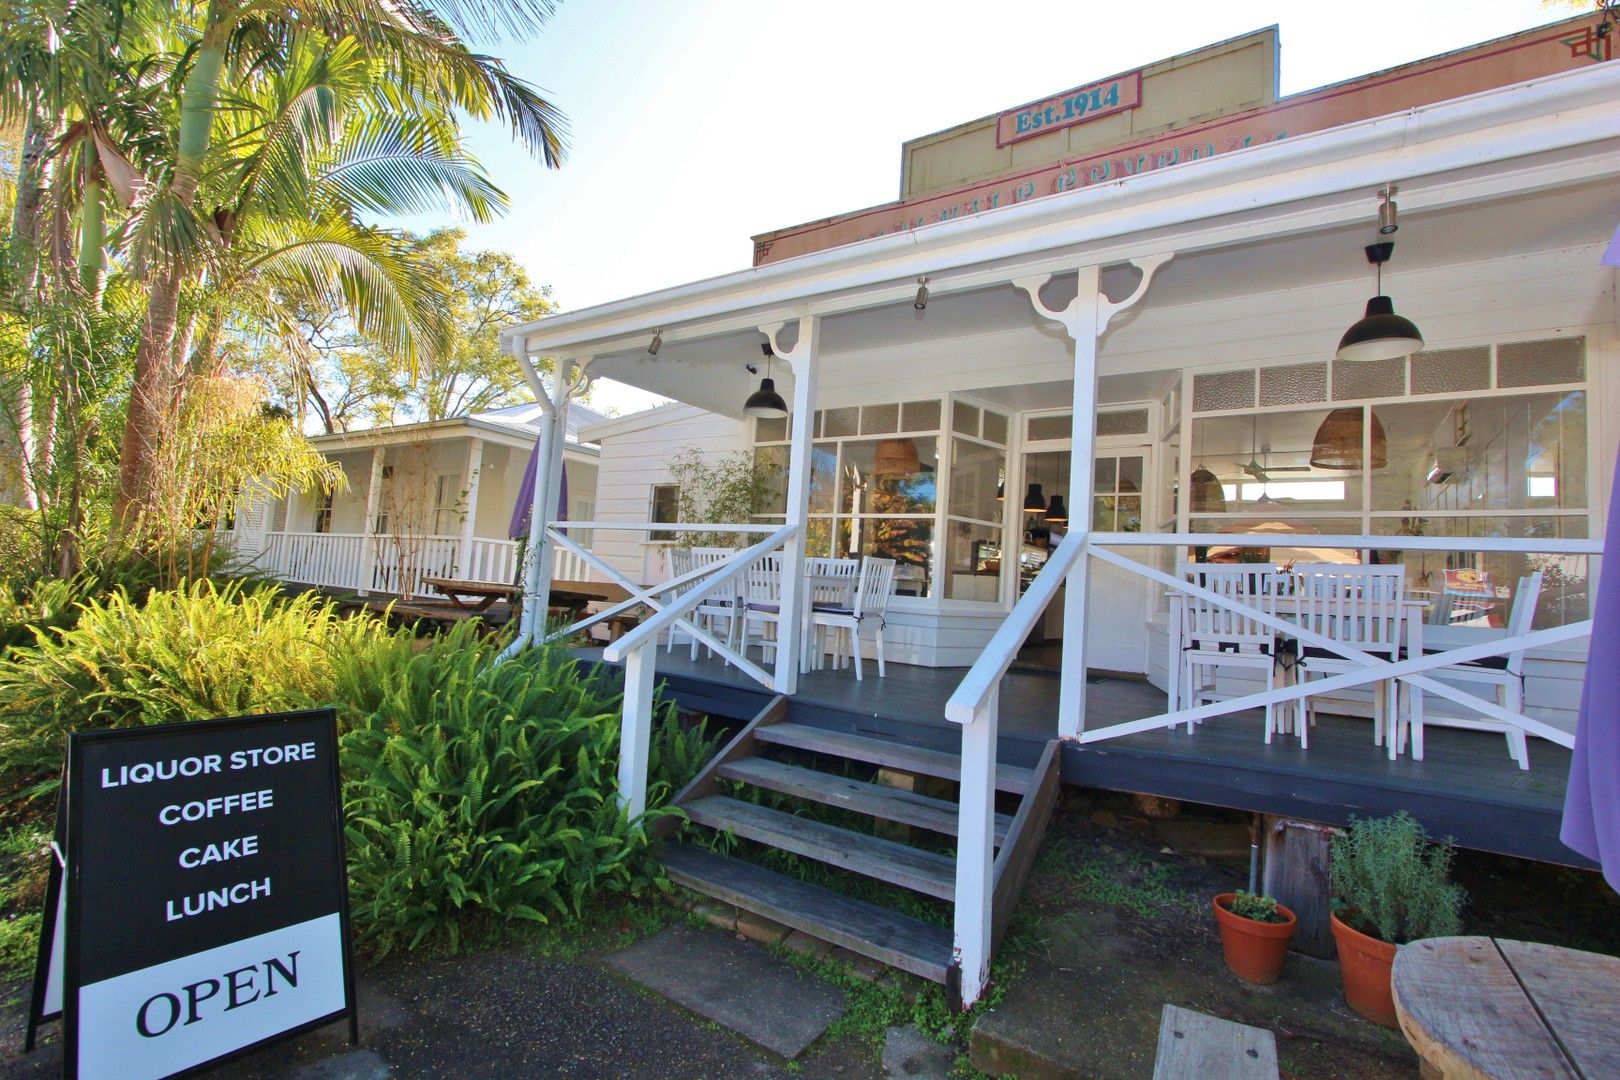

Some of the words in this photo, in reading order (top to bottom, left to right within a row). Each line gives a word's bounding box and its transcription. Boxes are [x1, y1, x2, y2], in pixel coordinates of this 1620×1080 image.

[101, 754, 221, 788] LIQUOR
[230, 742, 315, 769] STORE
[159, 789, 273, 825] COFFEE
[179, 835, 258, 869] CAKE
[166, 877, 271, 922] LUNCH
[136, 951, 300, 1038] OPEN
